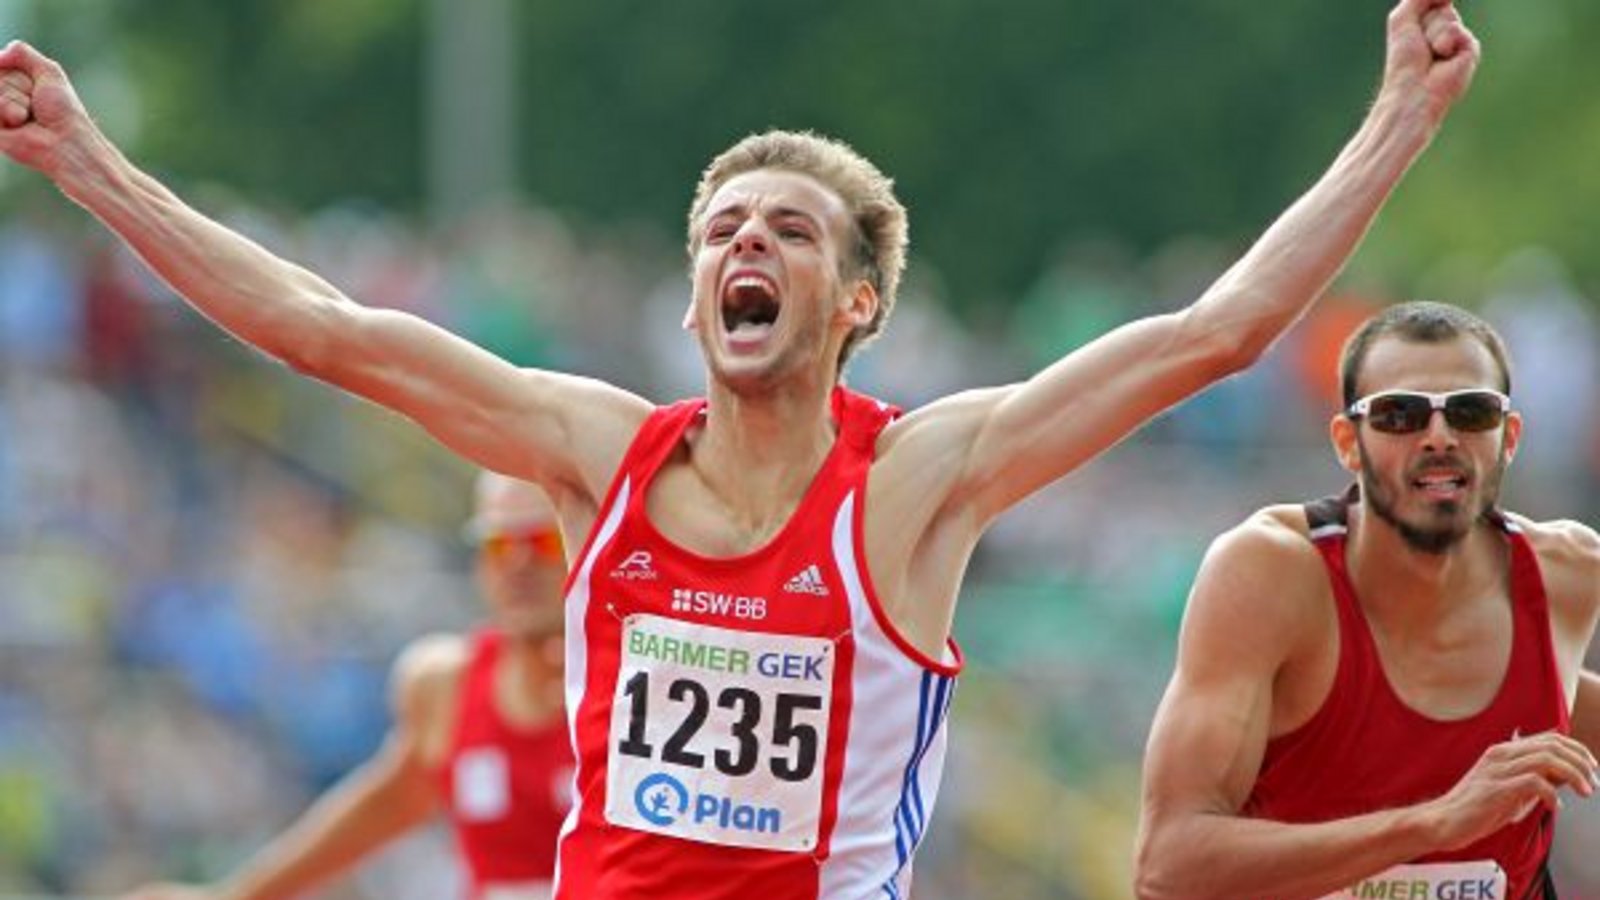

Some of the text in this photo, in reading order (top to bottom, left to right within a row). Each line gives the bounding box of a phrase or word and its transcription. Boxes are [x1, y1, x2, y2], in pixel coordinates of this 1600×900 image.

[628, 630, 825, 681] BARMER GEK
[618, 671, 822, 782] 1235
[694, 793, 781, 833] Plan
[1436, 879, 1495, 900] GEK
